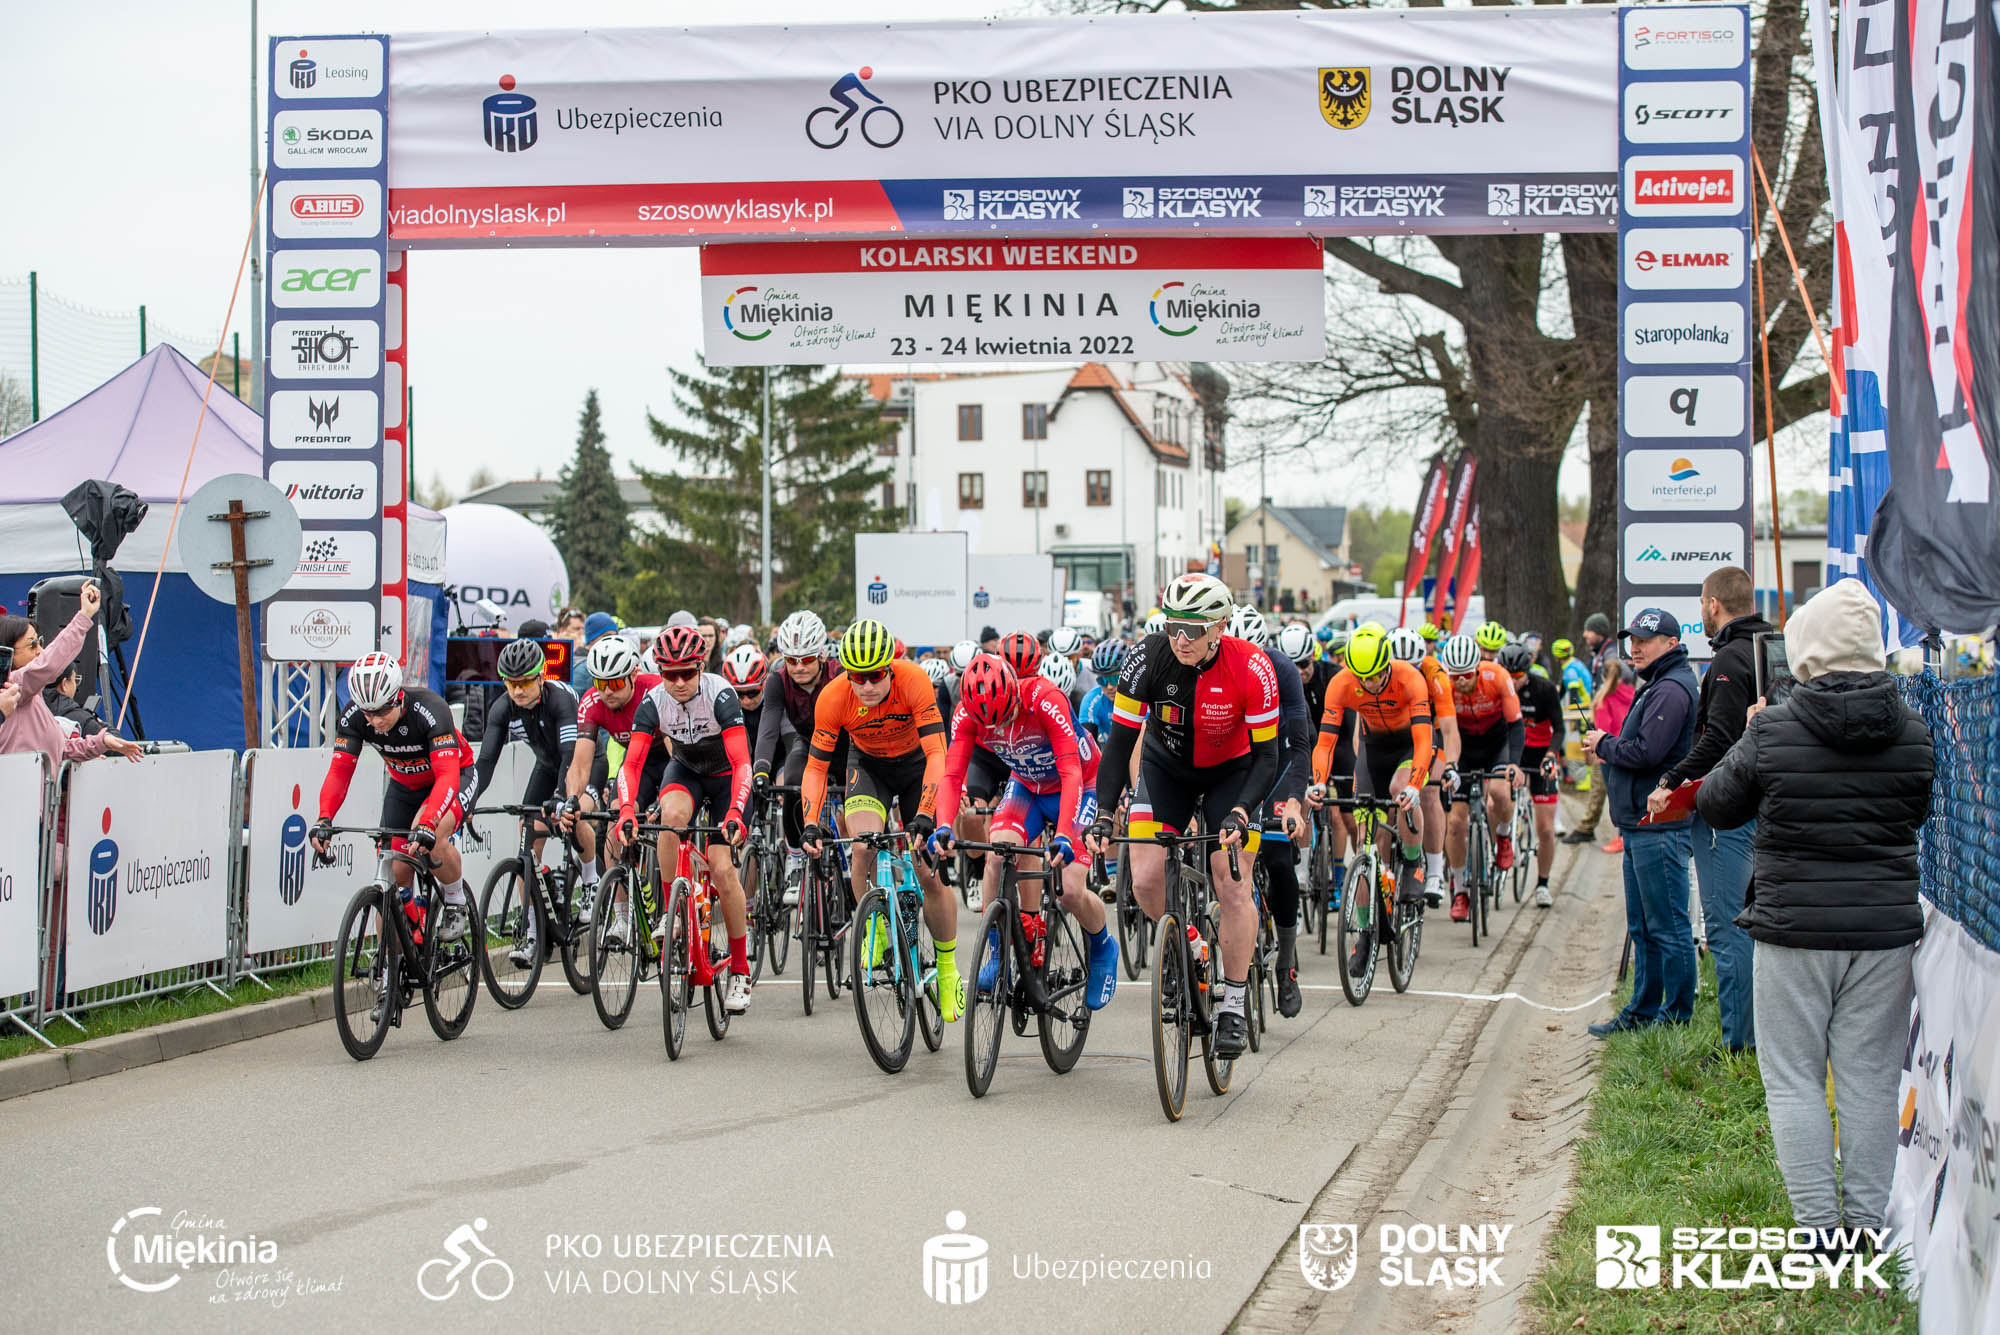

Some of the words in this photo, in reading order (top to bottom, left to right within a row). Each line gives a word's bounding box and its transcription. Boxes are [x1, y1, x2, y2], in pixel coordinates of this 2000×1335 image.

[1655, 31, 1734, 40] FORTISGO
[325, 67, 368, 81] Leasing
[1391, 66, 1512, 92] DOLNY
[934, 80, 991, 105] PKO
[1003, 75, 1233, 104] UBEZPIECZENIA
[557, 107, 722, 130] Ubezpieczenia
[1391, 90, 1504, 128] ŚLĄSK
[1652, 108, 1734, 119] SCOTT
[307, 128, 374, 141] ŠKODA
[934, 115, 984, 140] VIA
[995, 113, 1094, 140] DOLNY
[1105, 109, 1197, 145] ŚLĄSK
[287, 147, 324, 155] GALL-ICM
[327, 147, 368, 155] WROCŁAW
[979, 188, 1082, 202] SZOSOWY
[1158, 187, 1263, 201] SZOSOWY
[1340, 186, 1446, 198] SZOSOWY
[301, 199, 354, 214] ABUS
[388, 202, 566, 230] viadolnyslask.pl
[637, 198, 834, 224] szosowyklasyk.pl
[979, 202, 1081, 220] KLASYK
[1158, 200, 1263, 218] KLASYK
[1340, 198, 1445, 217] KLASYK
[860, 247, 993, 267] KOLARSKI
[1003, 245, 1138, 266] WEEKEND
[1662, 253, 1730, 267] ELMAR
[281, 268, 372, 292] acer
[764, 288, 800, 308] Gmina
[1191, 283, 1228, 304] Gmina
[741, 303, 833, 326] Miękinia
[905, 293, 1119, 323] MIĘKINIA
[1167, 299, 1260, 322] Miękinia
[1634, 323, 1729, 345] Staropolanka
[891, 338, 916, 356] 23
[941, 337, 967, 355] 24
[976, 336, 1072, 356] kwietnia
[1079, 336, 1134, 355] 2022
[299, 484, 364, 500] vittoria
[1652, 485, 1717, 497] interferie.pl
[1671, 551, 1733, 561] INPEAK
[327, 563, 349, 572] LINE
[127, 849, 211, 899] Ubezpieczenia
